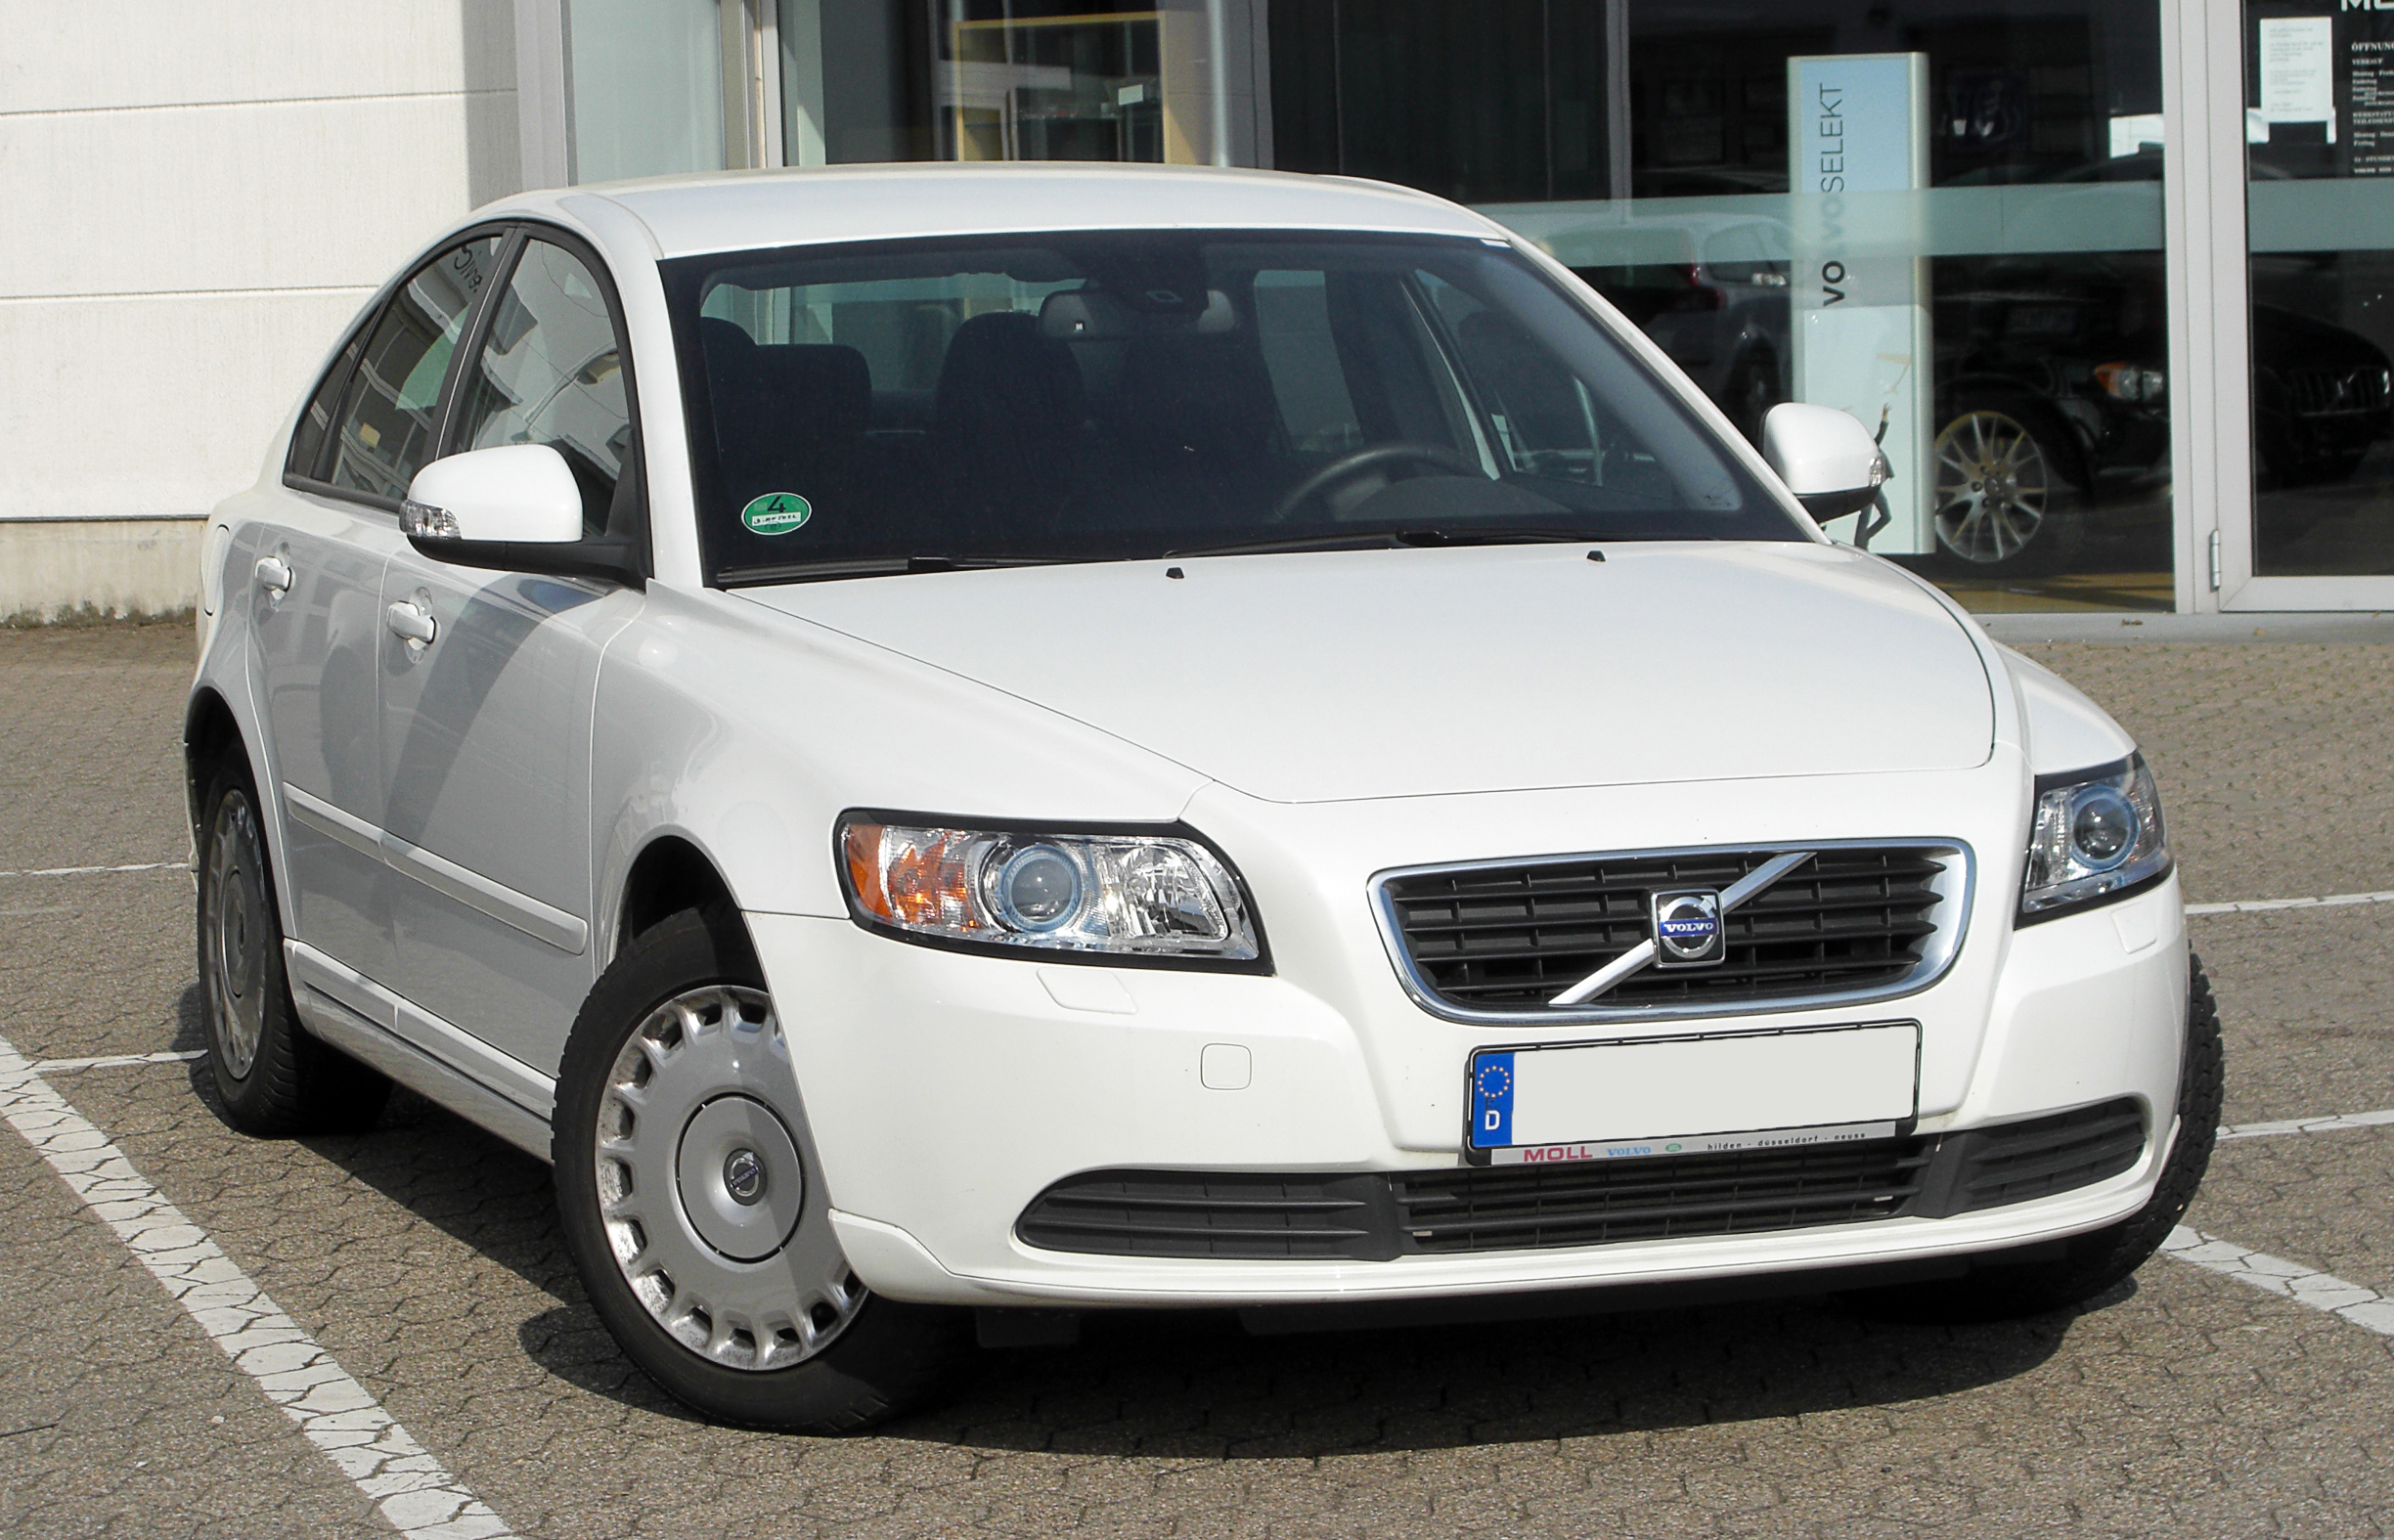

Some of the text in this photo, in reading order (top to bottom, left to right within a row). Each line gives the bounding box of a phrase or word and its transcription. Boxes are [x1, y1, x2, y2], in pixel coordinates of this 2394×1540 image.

[767, 495, 786, 513] 4
[1663, 922, 1713, 933] VOLVO
[1485, 1110, 1501, 1131] D
[1524, 1132, 1866, 1163] MOLL VOLVO hilden düsseldorf neuss
